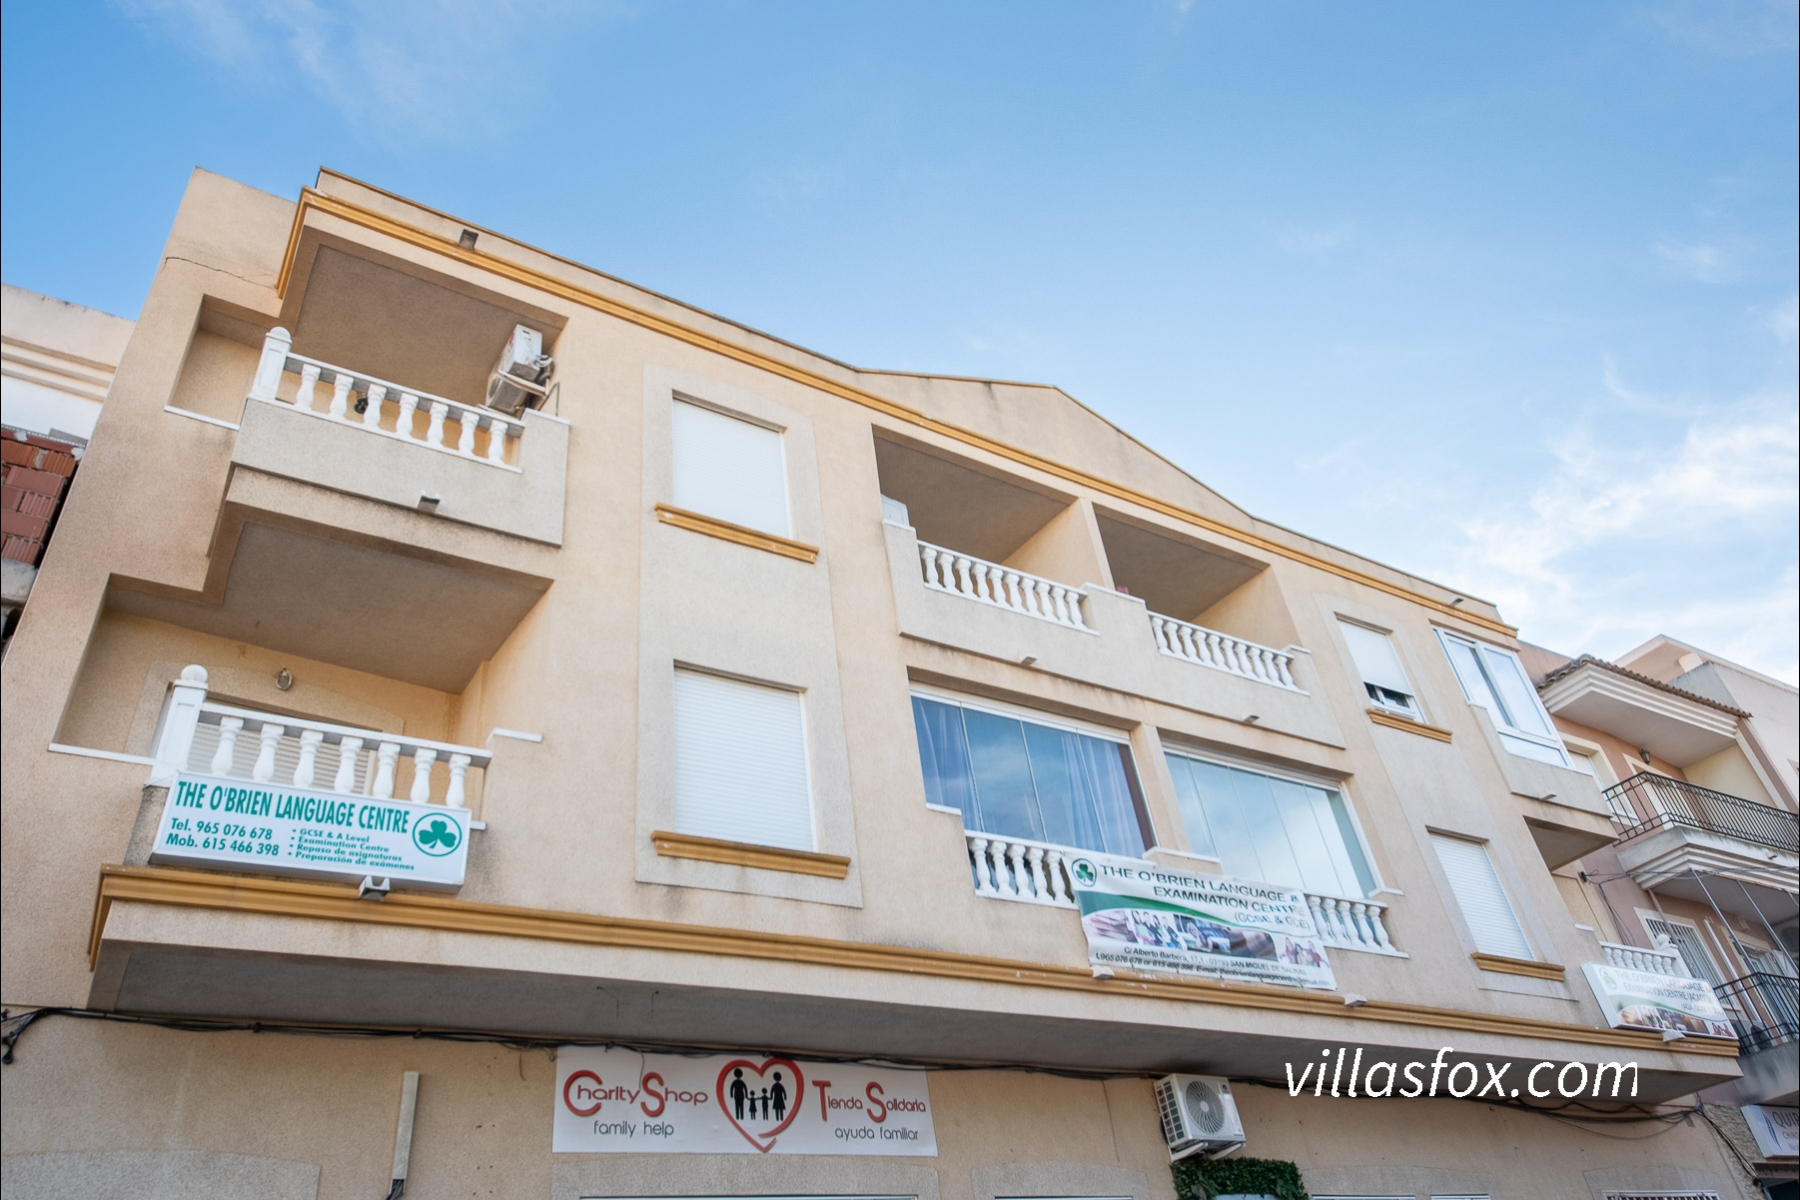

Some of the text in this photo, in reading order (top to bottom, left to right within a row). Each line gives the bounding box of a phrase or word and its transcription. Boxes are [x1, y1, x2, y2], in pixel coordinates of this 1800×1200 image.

[175, 781, 411, 834] THE O'BRIEN LANGUAGE CENTRE
[170, 817, 273, 840] Tel. 965 076 678
[299, 828, 370, 843] GCSE & A Level
[165, 833, 280, 857] Mob. 615 466 398
[296, 843, 402, 862] Repaso de asignaturas
[298, 836, 390, 853] Examination Centre
[295, 851, 353, 865] Preparación
[355, 856, 368, 865] de
[1099, 864, 1299, 902] THE O'BRIEN LANGUAGE &
[1153, 886, 1249, 910] EXAMINATION
[1274, 915, 1284, 924] &
[1133, 948, 1159, 957] Alberto
[562, 1070, 709, 1117] Charity Shop
[811, 1080, 927, 1124] Tienda Solidaria
[592, 1120, 675, 1138] family help
[833, 1126, 919, 1142] ayuda familiar
